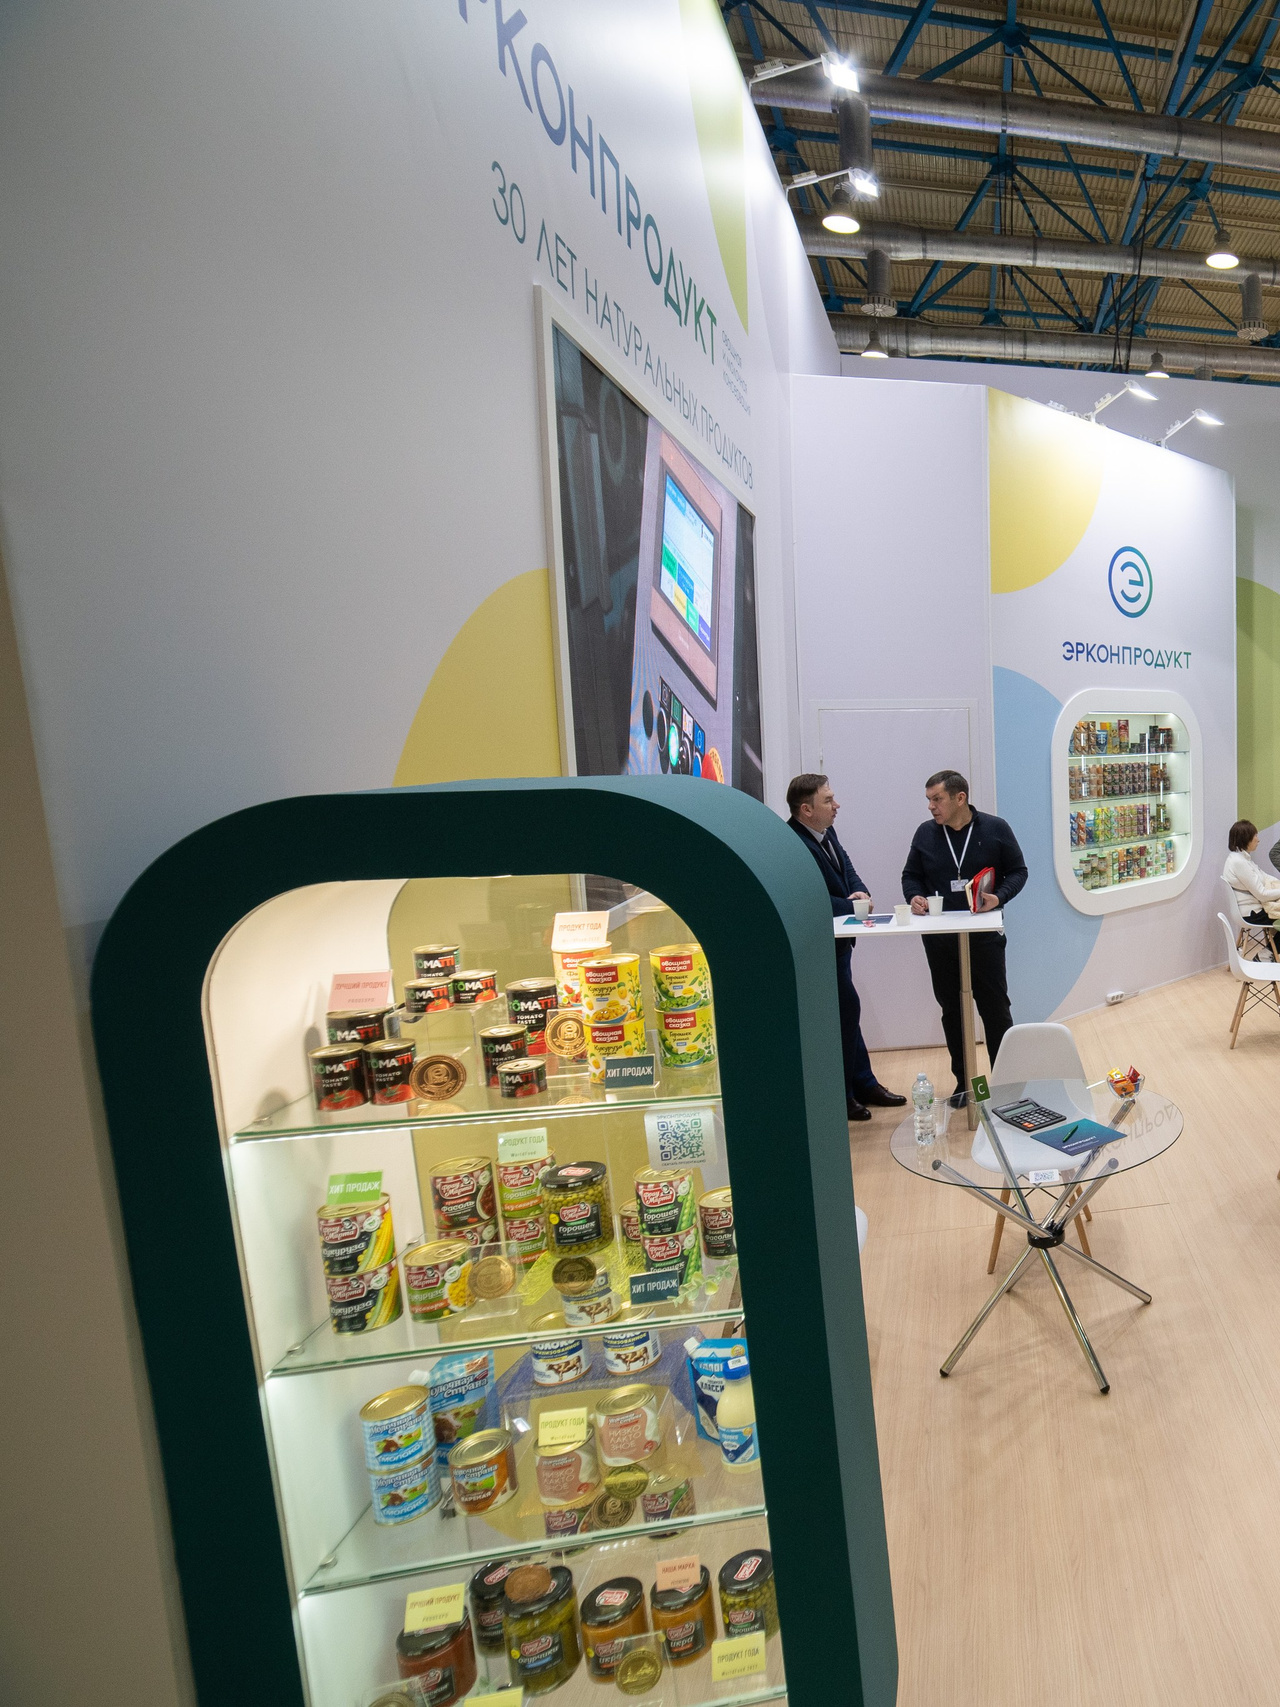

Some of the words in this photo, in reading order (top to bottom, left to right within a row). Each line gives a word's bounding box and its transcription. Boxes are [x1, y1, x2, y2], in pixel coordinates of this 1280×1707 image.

[459, 0, 717, 365] КОНПРОДУКТ
[491, 161, 526, 244] 30
[536, 218, 578, 299] ЛЕТ
[585, 268, 698, 432] НАТУРАЛЬНЫХ
[701, 405, 753, 490] ПРОДУКТОВ
[1062, 641, 1192, 669] ЭРКОНПРОДУКТ
[559, 923, 585, 932] ПРОДУКТ
[586, 922, 602, 930] ГОДА
[362, 980, 388, 989] ПРОДУКТ
[606, 1068, 620, 1078] ХИТ
[622, 1066, 653, 1077] ПРОДАЖ
[329, 1184, 344, 1194] ХИТ
[345, 1181, 380, 1192] ПРОДАЖ
[631, 1281, 645, 1293] ХИТ
[646, 1278, 678, 1291] ПРОДАЖ
[431, 1375, 475, 1397] олочная
[540, 1420, 568, 1430] ПРОДУКТ
[569, 1417, 585, 1427] ГОДА
[678, 1562, 695, 1572] МАРКА
[434, 1594, 461, 1605] ПРОДУКТ
[717, 1652, 743, 1664] ПРОДУКТ
[744, 1648, 760, 1658] ГОДА
